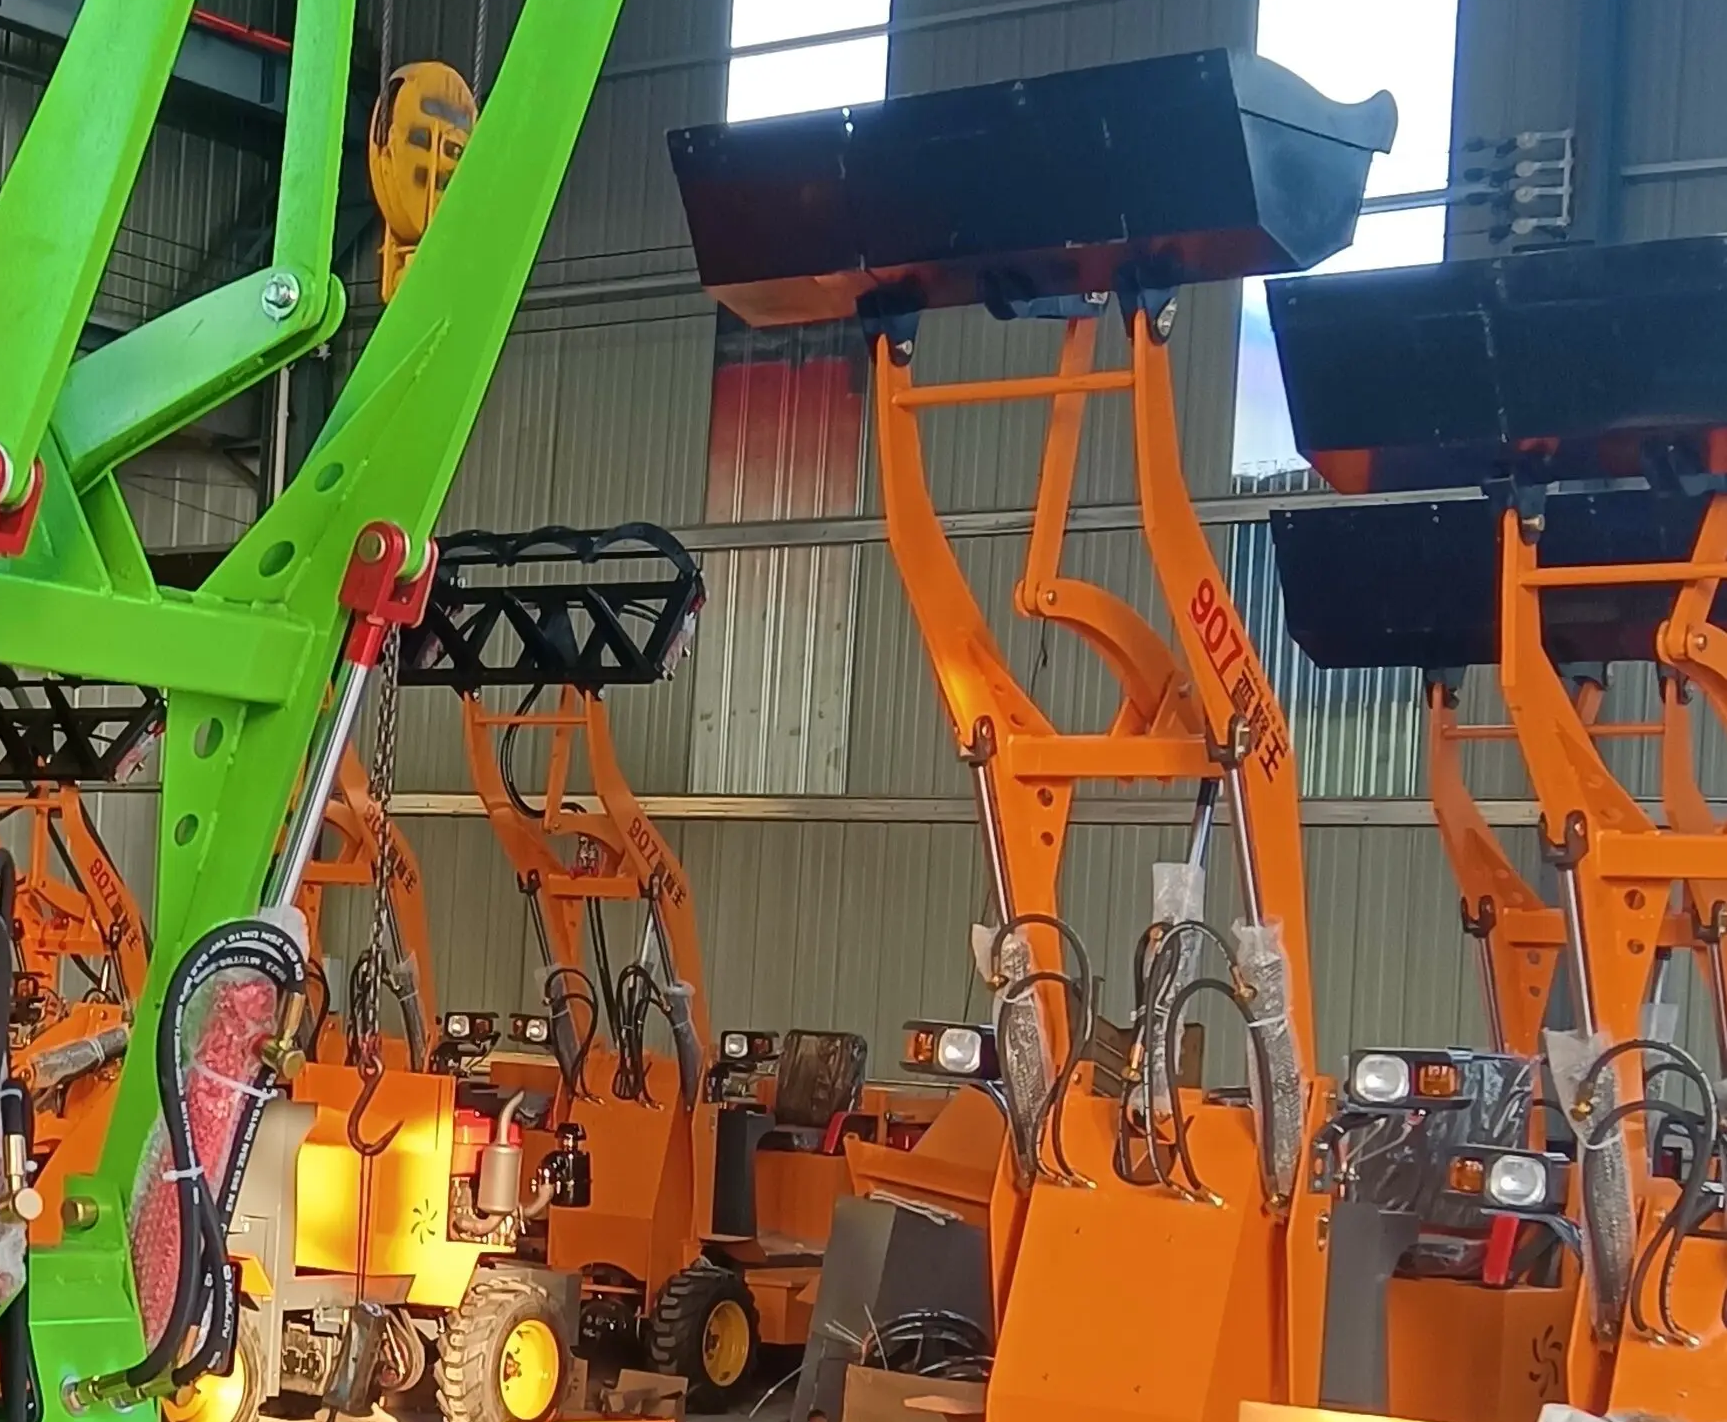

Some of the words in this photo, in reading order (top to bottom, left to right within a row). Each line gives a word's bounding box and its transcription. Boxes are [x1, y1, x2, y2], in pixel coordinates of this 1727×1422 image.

[1191, 578, 1243, 677] 907
[629, 817, 659, 862] 907
[89, 858, 118, 902] 907
